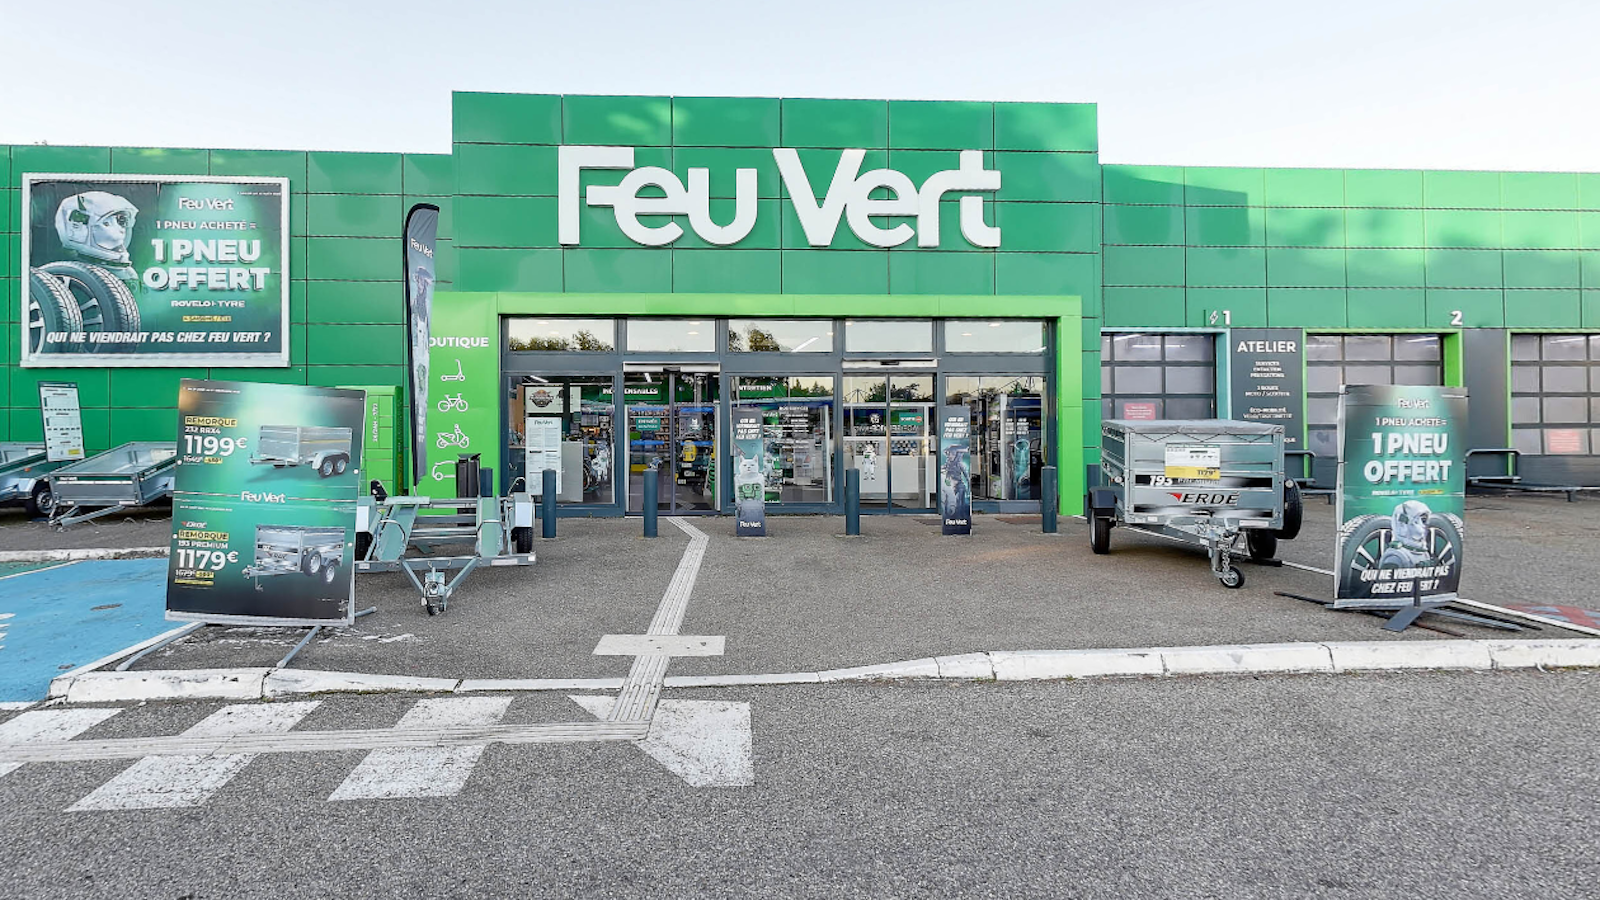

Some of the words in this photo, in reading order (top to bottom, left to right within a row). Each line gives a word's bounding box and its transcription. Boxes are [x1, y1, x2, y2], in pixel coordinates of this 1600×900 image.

[178, 197, 204, 210] Feu
[206, 198, 234, 210] Vert
[558, 145, 758, 246] Feu
[772, 147, 1001, 248] Vert
[156, 220, 161, 229] 1
[164, 220, 197, 230] PNEU
[200, 220, 247, 230] ACHETÉ
[151, 238, 164, 261] 1
[172, 239, 261, 262] PNEU
[410, 237, 422, 252] Feu
[143, 267, 271, 290] OFFERT
[1222, 310, 1231, 326] 1
[1450, 310, 1463, 326] 2
[46, 332, 67, 343] QUI
[69, 332, 86, 343] NE
[89, 332, 150, 343] VIENDRAIT
[151, 332, 174, 343] PAS
[176, 332, 206, 343] CHEZ
[208, 332, 230, 343] FEU
[232, 332, 261, 343] VERT
[263, 332, 271, 343] ?
[428, 336, 490, 349] OUTIQUE
[1237, 340, 1297, 353] ATELIER
[186, 417, 236, 426] REMORQUE
[1375, 417, 1380, 426] 1
[1382, 417, 1406, 426] PNEU
[1408, 416, 1441, 427] ACHETÉ
[184, 435, 248, 456] 1199€
[1371, 432, 1384, 455] 1
[1388, 432, 1449, 456] PNEU
[1364, 460, 1453, 483] OFFERT
[241, 491, 262, 502] Feu
[263, 492, 286, 504] Vert
[1182, 491, 1240, 505] ERDÉ
[180, 531, 228, 540] REMORQUE
[191, 541, 229, 550] PREMIUM
[177, 548, 239, 571] 1179€
[1360, 568, 1379, 583] QUI
[1378, 569, 1393, 580] NE
[1393, 567, 1435, 579] VIENDRAIT
[1434, 565, 1450, 576] PAS
[1371, 582, 1397, 594] CHEZ
[1396, 581, 1415, 593] FEU
